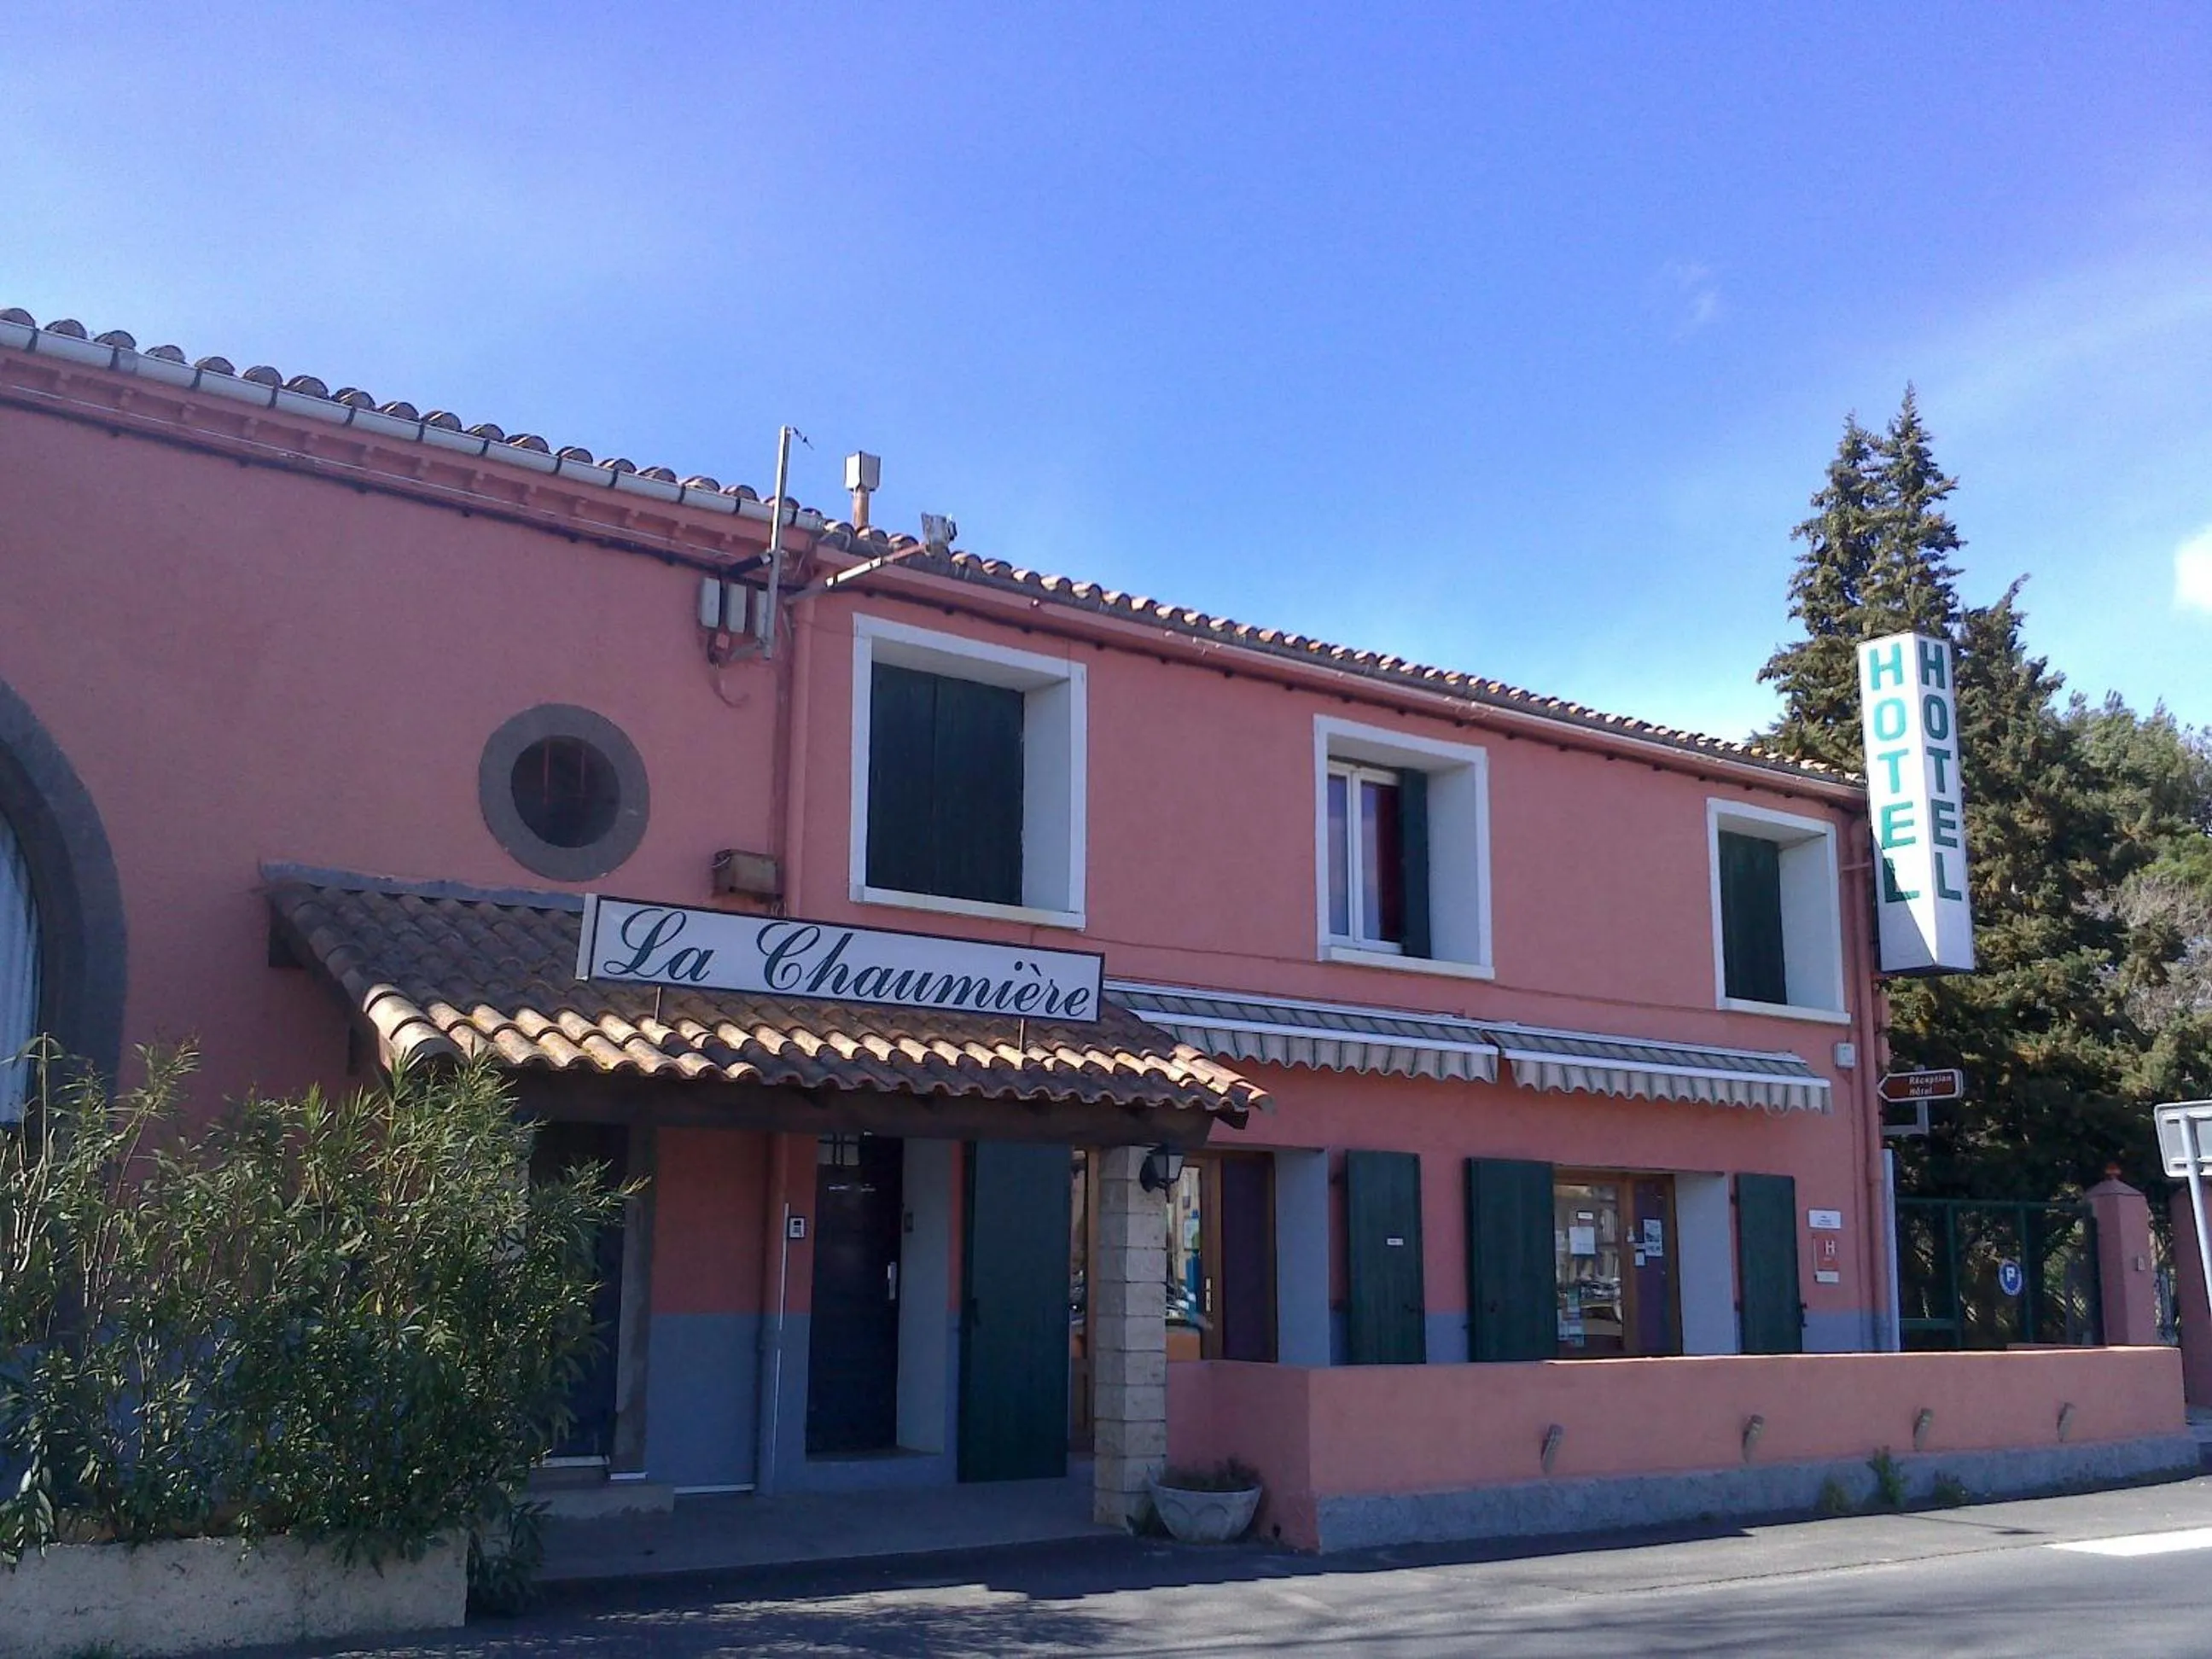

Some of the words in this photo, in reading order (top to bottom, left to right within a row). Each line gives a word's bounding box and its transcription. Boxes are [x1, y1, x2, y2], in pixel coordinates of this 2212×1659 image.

[1870, 642, 1919, 903] HOTEL
[1918, 640, 1963, 902] HOTEL
[603, 907, 717, 981] La
[756, 922, 1091, 1018] Chaumière
